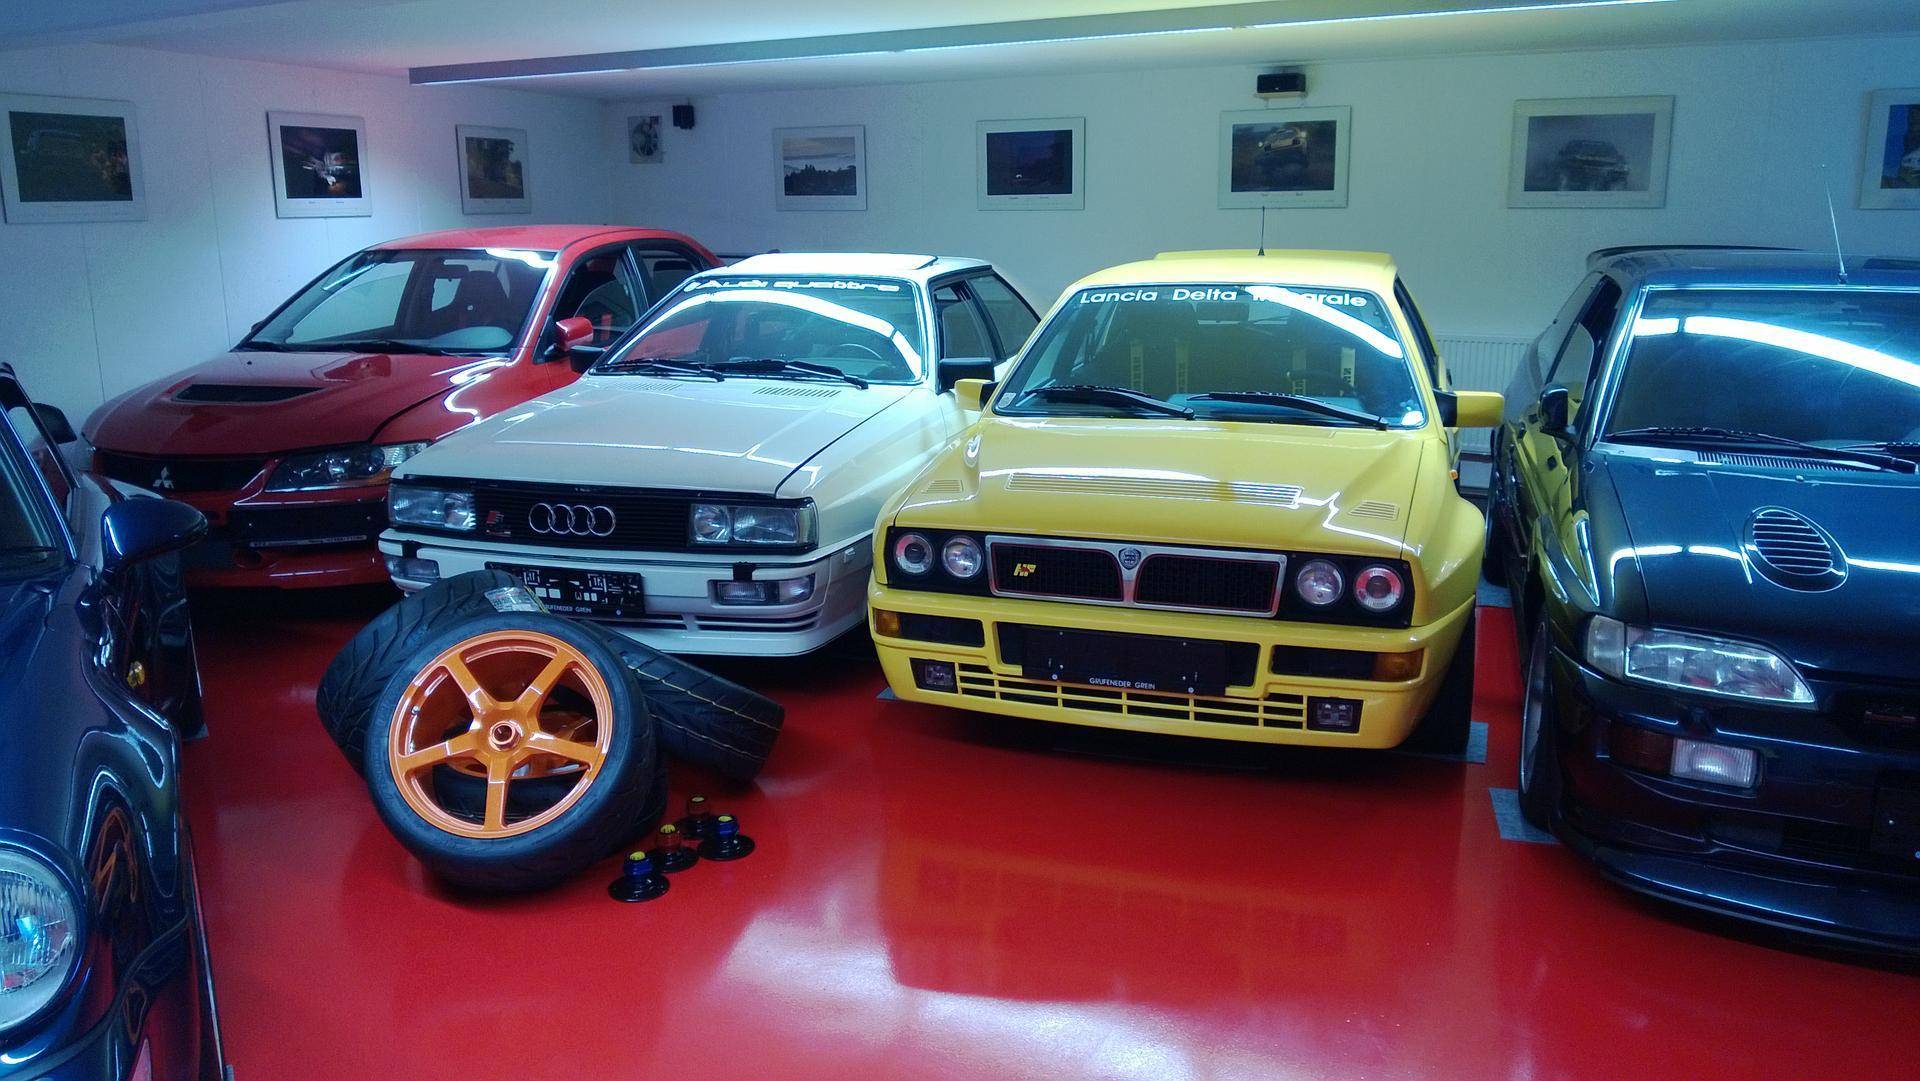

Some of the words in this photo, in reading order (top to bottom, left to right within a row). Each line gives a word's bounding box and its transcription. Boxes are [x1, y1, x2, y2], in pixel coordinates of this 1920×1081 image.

[696, 280, 769, 289] Audi
[774, 281, 899, 291] quattro
[1080, 288, 1158, 304] Lancia
[1172, 288, 1238, 302] Delta
[1135, 682, 1155, 690] GREIN
